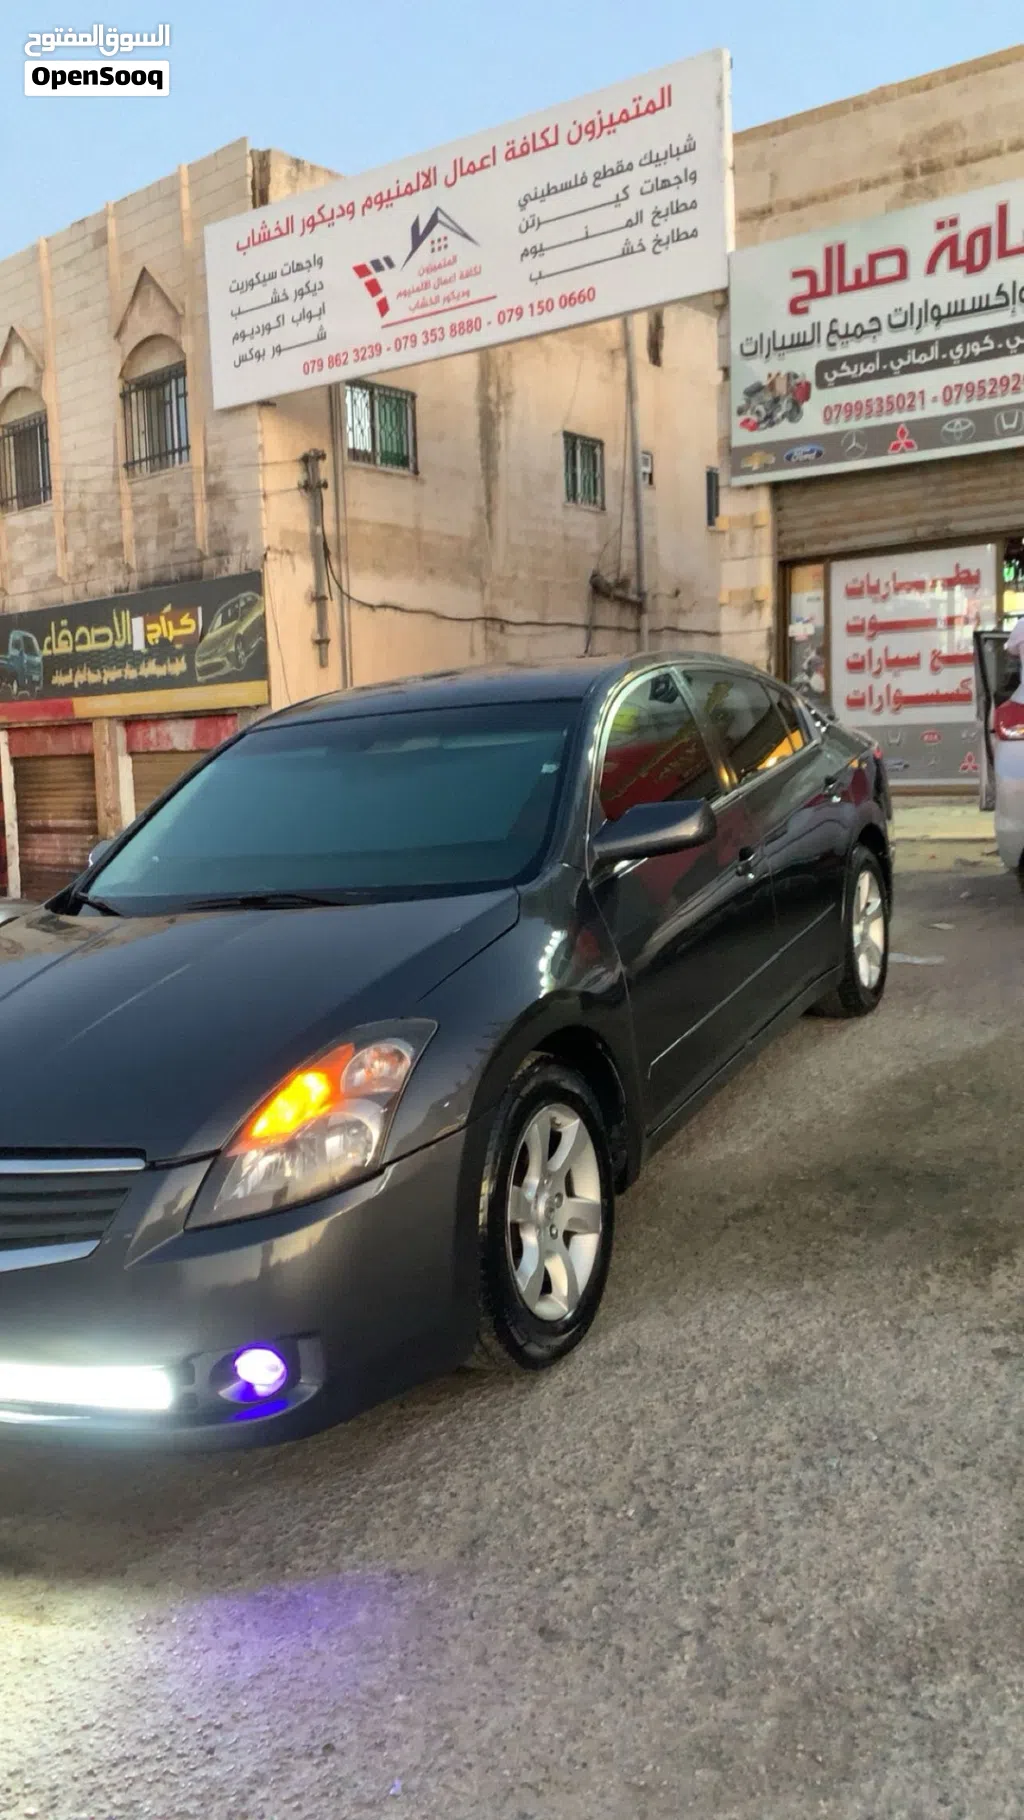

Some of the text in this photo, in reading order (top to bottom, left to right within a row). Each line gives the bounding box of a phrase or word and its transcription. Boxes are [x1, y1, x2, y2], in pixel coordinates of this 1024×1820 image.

[236, 84, 672, 256] المتميزون لكافة اعمال الالمنيوم وديكور الخشاب
[517, 134, 697, 211] شبابيك مقطع فلسطيني
[640, 167, 697, 195] واجهات
[651, 199, 698, 227] مطابخ
[652, 227, 699, 255] مطابخ
[789, 201, 1024, 316] امة صالح
[229, 253, 324, 295] واجهات سيكوريت
[293, 280, 324, 303] ديكور
[291, 302, 326, 327] ابواب
[302, 358, 324, 375] 079
[327, 351, 349, 369] 862
[352, 342, 383, 363] 3239
[394, 334, 418, 353] 079
[421, 327, 446, 346] 353
[449, 316, 482, 338] 8880
[497, 306, 524, 325] 079
[529, 298, 555, 317] 150
[558, 287, 596, 310] 0660
[739, 321, 821, 359] السيارات
[826, 318, 882, 347] جميع
[950, 334, 995, 365] كوري
[233, 347, 266, 369] بوكس
[823, 352, 880, 387] أمريكي
[889, 340, 940, 375] ألماني
[822, 390, 926, 424] 0799535021
[942, 372, 1024, 405] 0795292
[43, 608, 132, 656] الاصدقاء
[846, 678, 973, 714] كسسوارات
